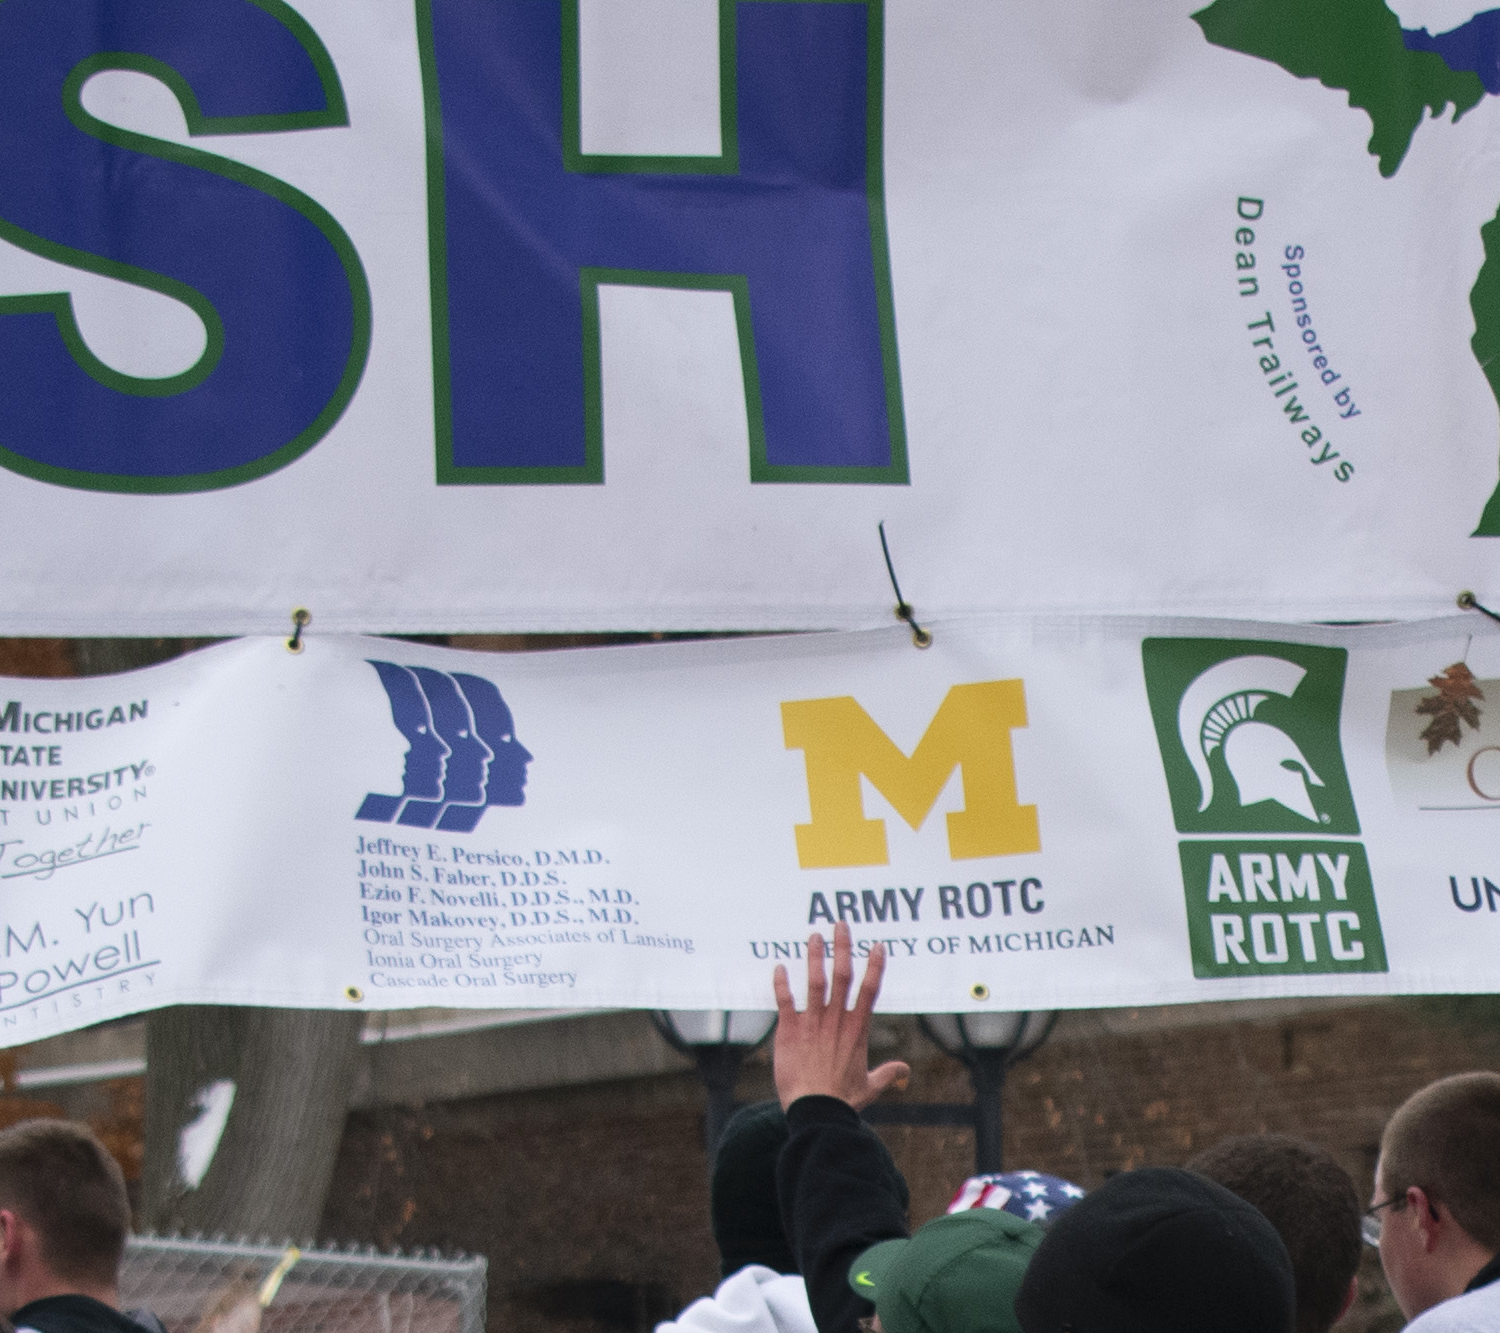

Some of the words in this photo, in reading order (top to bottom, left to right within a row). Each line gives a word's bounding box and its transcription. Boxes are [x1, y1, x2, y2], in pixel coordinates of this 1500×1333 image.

[1234, 197, 1264, 299] Dean
[1283, 244, 1342, 387] Sponsored
[1332, 376, 1362, 421] by
[1246, 311, 1356, 485] Trailways
[780, 678, 1042, 869] M
[34, 786, 150, 827] UNION
[355, 835, 420, 865] Jeffrey
[426, 843, 448, 864] E.
[451, 846, 531, 868] Persico,
[534, 848, 611, 867] D.M.D.
[356, 859, 406, 881] John
[409, 862, 429, 883] S.
[500, 869, 568, 888] D.D.S.
[1208, 852, 1351, 903] ARMY
[74, 890, 156, 935] Yun
[358, 881, 402, 902] Ezio
[407, 885, 426, 905] F.
[429, 888, 507, 909] Novelli,
[588, 887, 641, 906] M.D.
[808, 886, 925, 925] ARMY
[938, 876, 1046, 921] ROTC
[360, 904, 402, 929] Igor
[407, 908, 507, 933] Makovey,
[588, 906, 641, 926] M.D.
[1210, 911, 1367, 965] ROTC
[363, 928, 405, 949] Oral
[410, 931, 484, 953] Surgery
[490, 926, 593, 949] Associates
[597, 928, 618, 945] of
[621, 930, 696, 955] Lansing
[366, 948, 415, 969] Ionia
[419, 951, 463, 970] Oral
[466, 949, 544, 972] Surgery
[750, 935, 920, 960] UNIESTY
[927, 935, 962, 956] OF
[968, 924, 1116, 955] MICHIGAN
[368, 970, 447, 989] Cascade
[453, 970, 498, 988] Oral
[502, 967, 579, 989] Surgery
